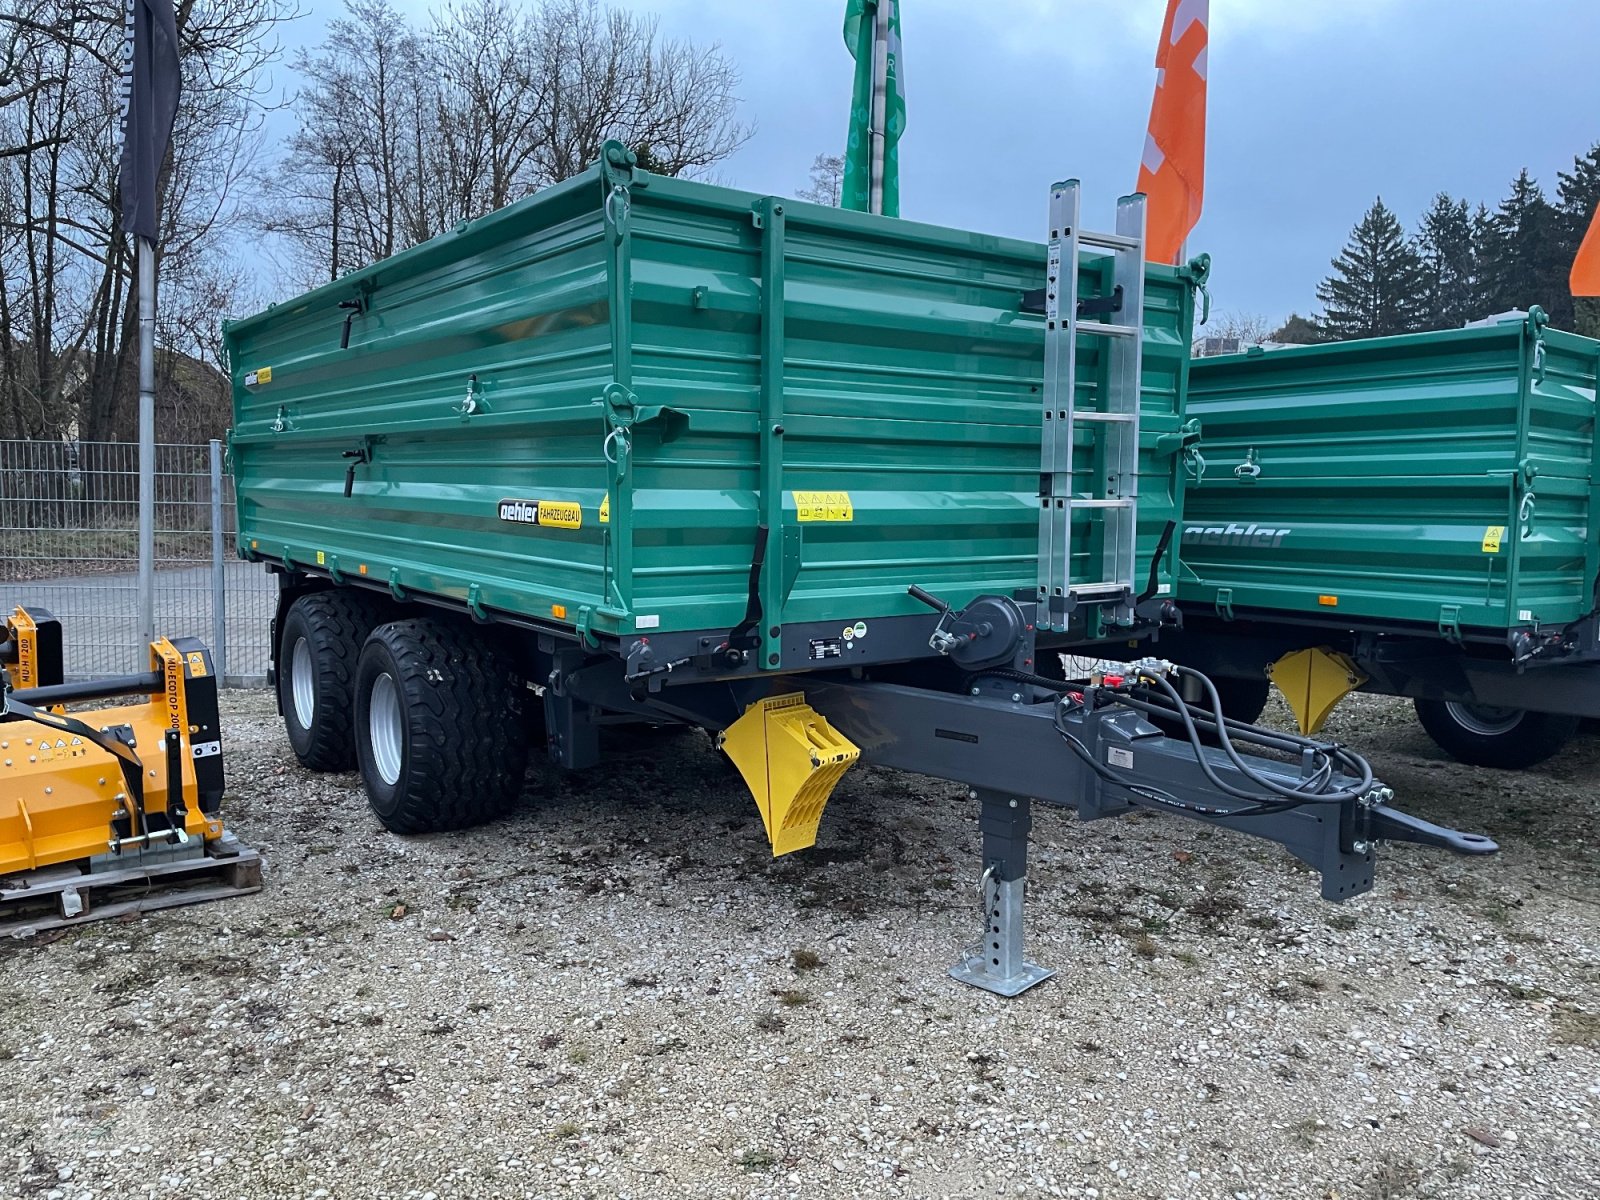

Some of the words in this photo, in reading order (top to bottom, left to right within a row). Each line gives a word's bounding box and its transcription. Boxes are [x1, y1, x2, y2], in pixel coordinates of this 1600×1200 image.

[500, 502, 538, 523] oehler
[540, 507, 580, 523] FAHRZEUGBAU
[1182, 523, 1291, 548] oehler
[21, 638, 29, 654] 200
[167, 657, 178, 710] MU-ECOTOP
[170, 712, 180, 729] 200
